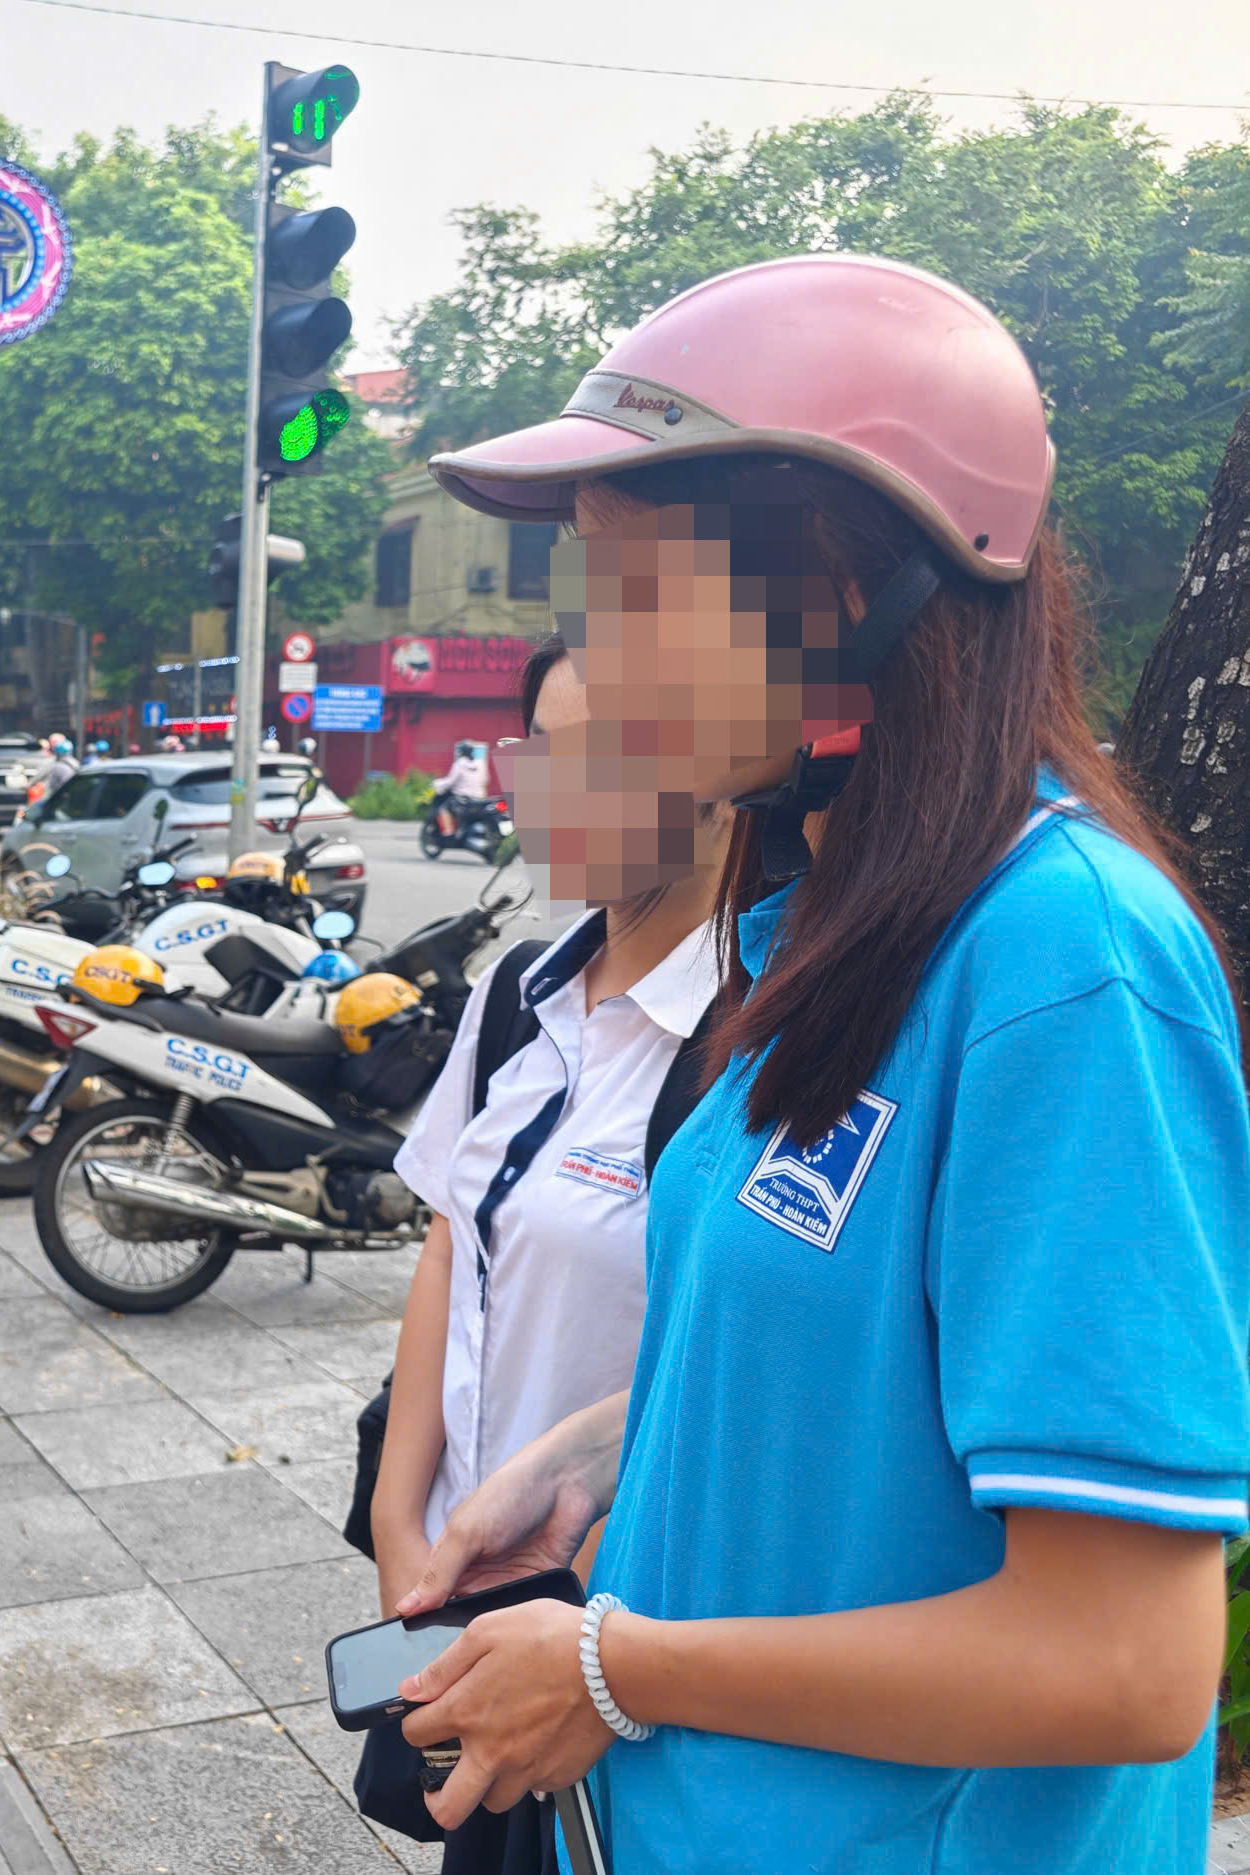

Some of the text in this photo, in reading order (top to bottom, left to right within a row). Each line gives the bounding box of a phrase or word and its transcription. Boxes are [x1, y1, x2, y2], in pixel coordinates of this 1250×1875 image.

[769, 1177, 820, 1213] TRƯỜNG THPT
[782, 1204, 806, 1225] HOÀN
